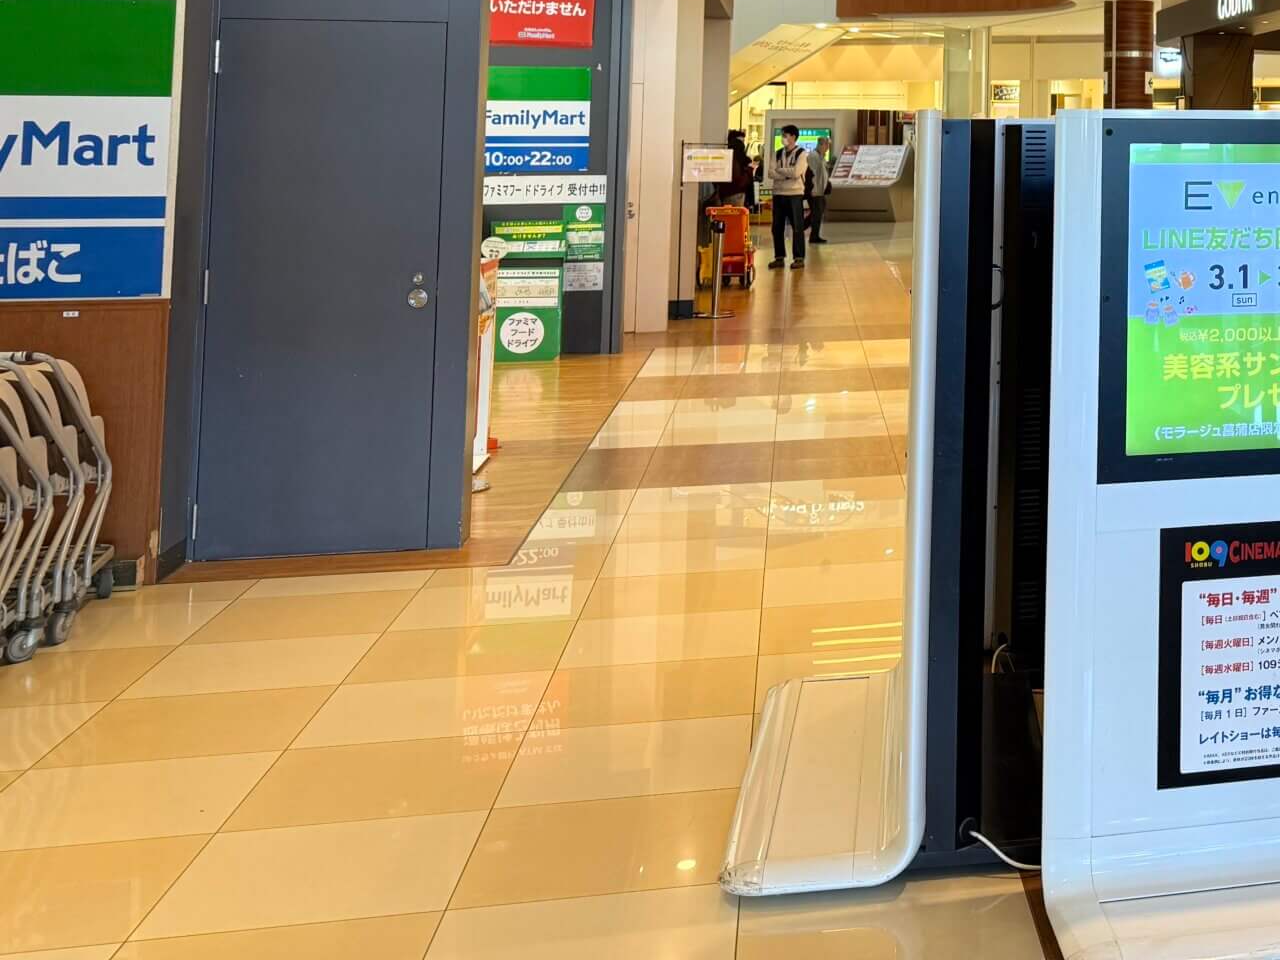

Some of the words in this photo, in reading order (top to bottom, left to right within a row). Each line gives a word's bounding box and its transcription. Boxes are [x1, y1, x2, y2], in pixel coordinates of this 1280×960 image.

[489, 0, 587, 17] いただけません
[0, 239, 82, 285] ばこ
[1207, 263, 1249, 290] 3.1
[1236, 296, 1254, 305] sun
[508, 317, 539, 327] ファミマ
[511, 327, 536, 337] フード
[506, 337, 540, 349] ドライブ
